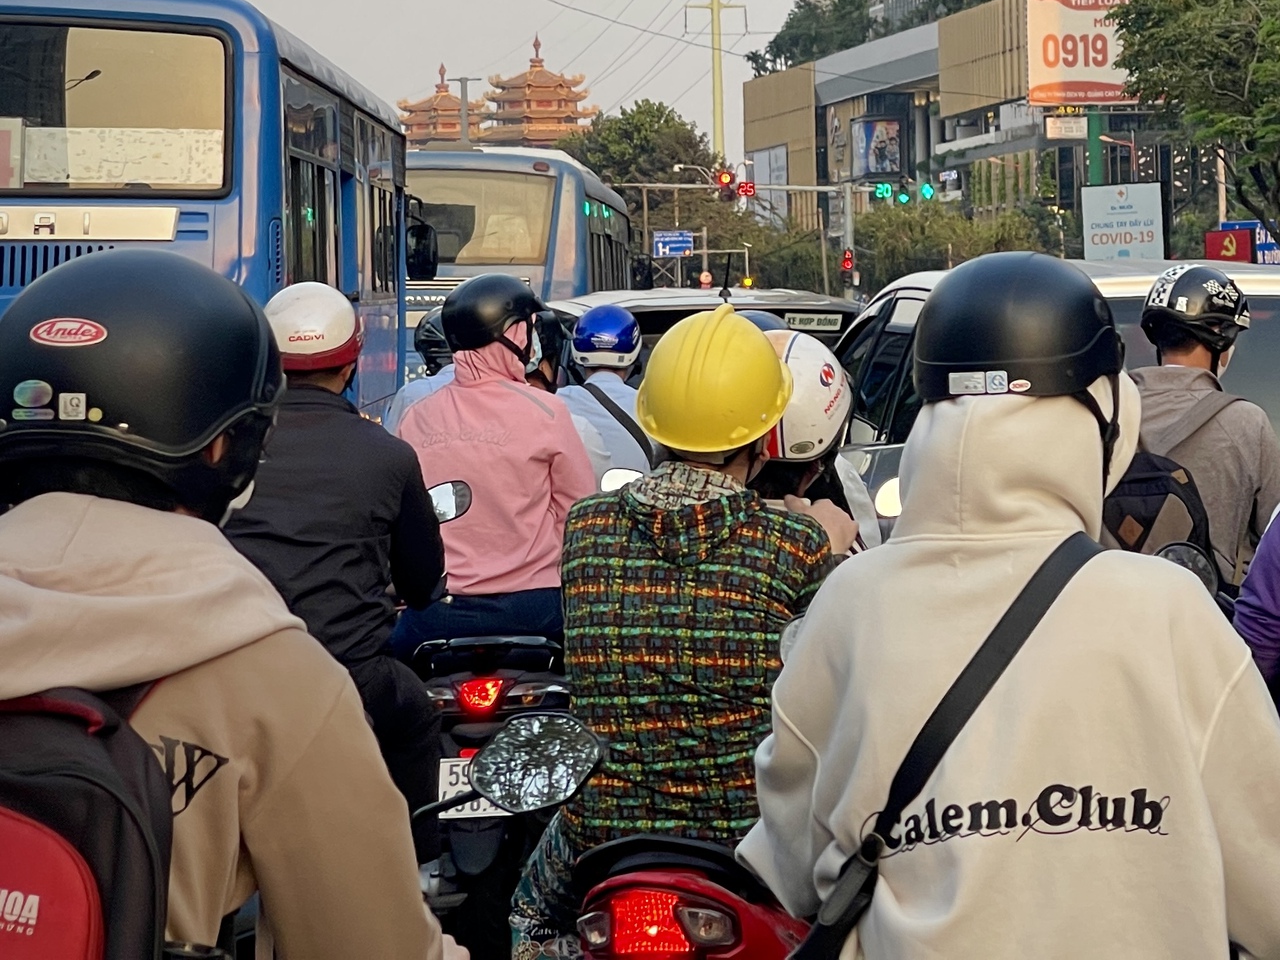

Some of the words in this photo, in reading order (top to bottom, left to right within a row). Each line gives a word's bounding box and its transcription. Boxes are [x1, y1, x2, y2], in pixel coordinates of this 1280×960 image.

[1042, 34, 1108, 69] 0919
[739, 183, 754, 195] 25
[875, 183, 892, 198] 20
[1091, 230, 1154, 246] COVID-19
